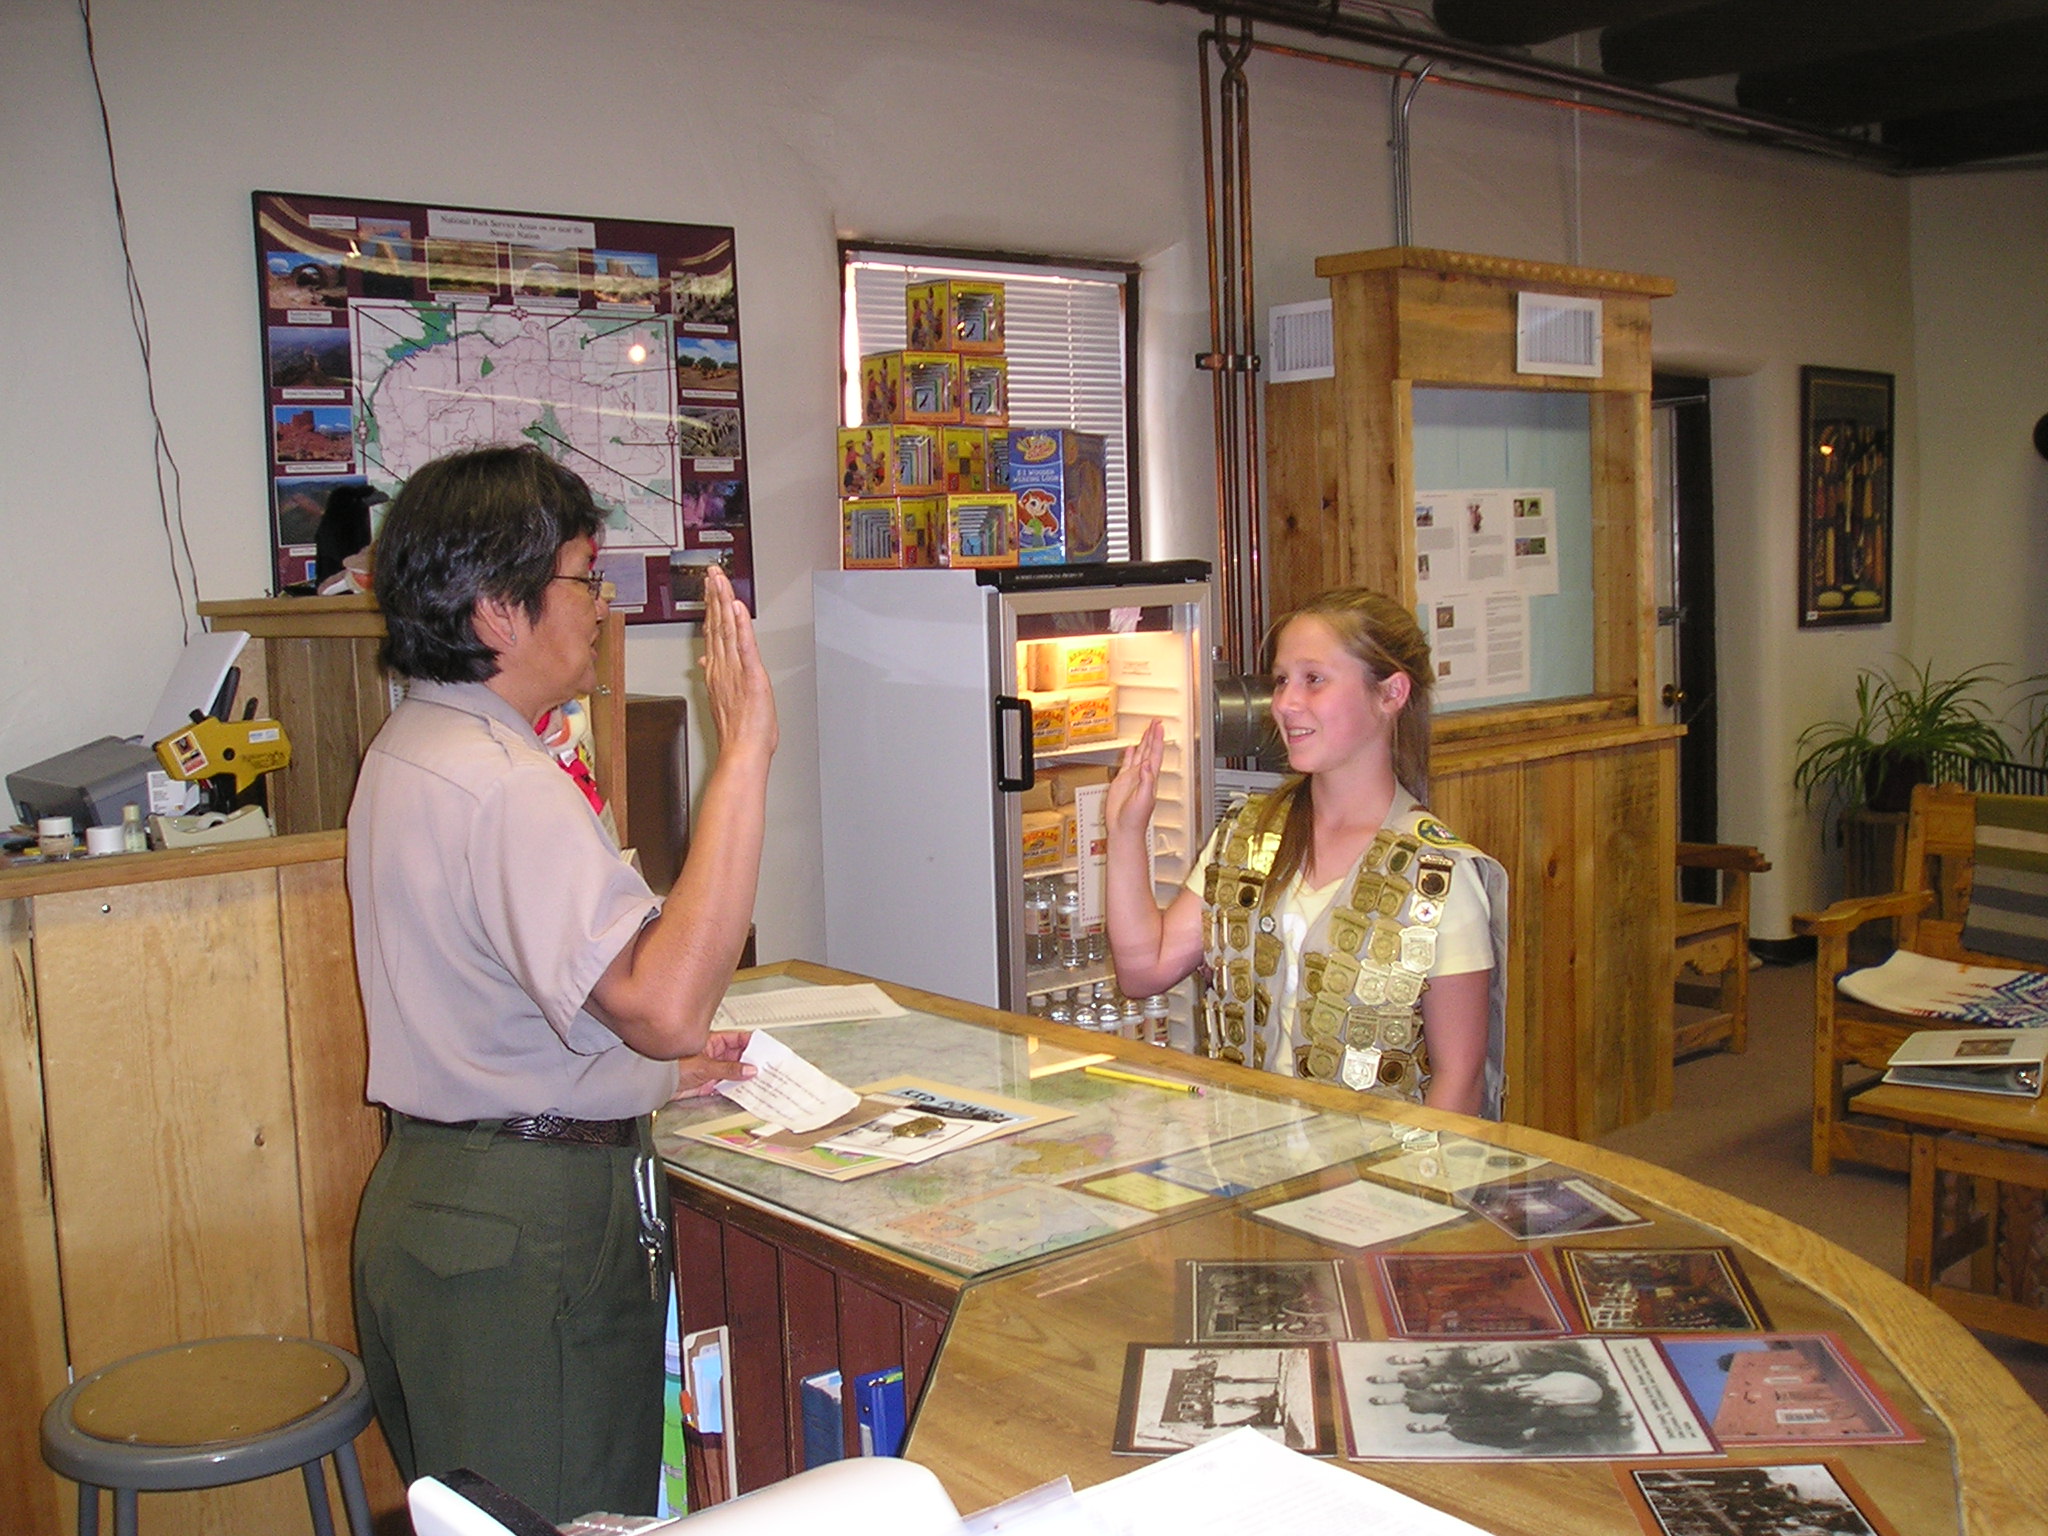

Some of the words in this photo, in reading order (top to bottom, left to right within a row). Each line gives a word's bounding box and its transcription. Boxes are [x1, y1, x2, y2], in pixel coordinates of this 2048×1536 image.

[440, 215, 470, 226] National
[472, 217, 489, 227] Park
[490, 219, 516, 230] Service
[490, 229, 514, 239] Navajo
[517, 231, 541, 240] Nation
